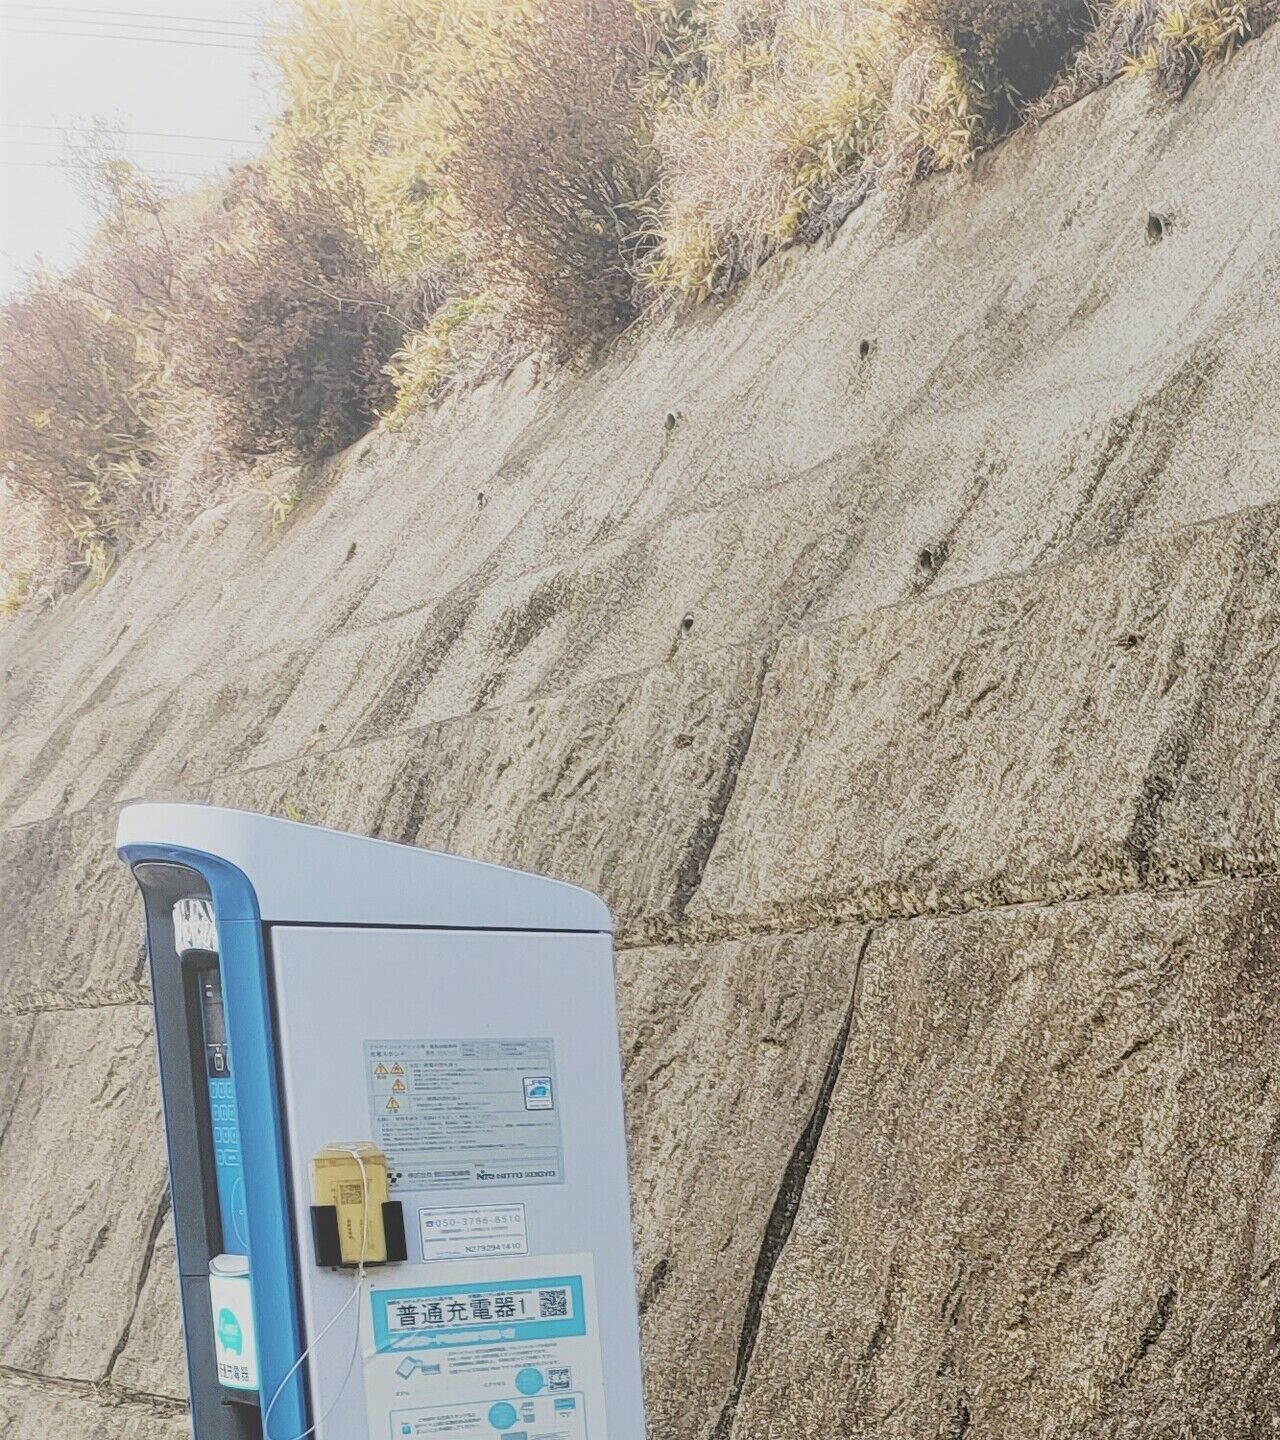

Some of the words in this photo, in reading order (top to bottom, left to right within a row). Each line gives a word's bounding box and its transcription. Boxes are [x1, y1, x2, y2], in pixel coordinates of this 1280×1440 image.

[396, 1296, 526, 1327] 普通充電器1
